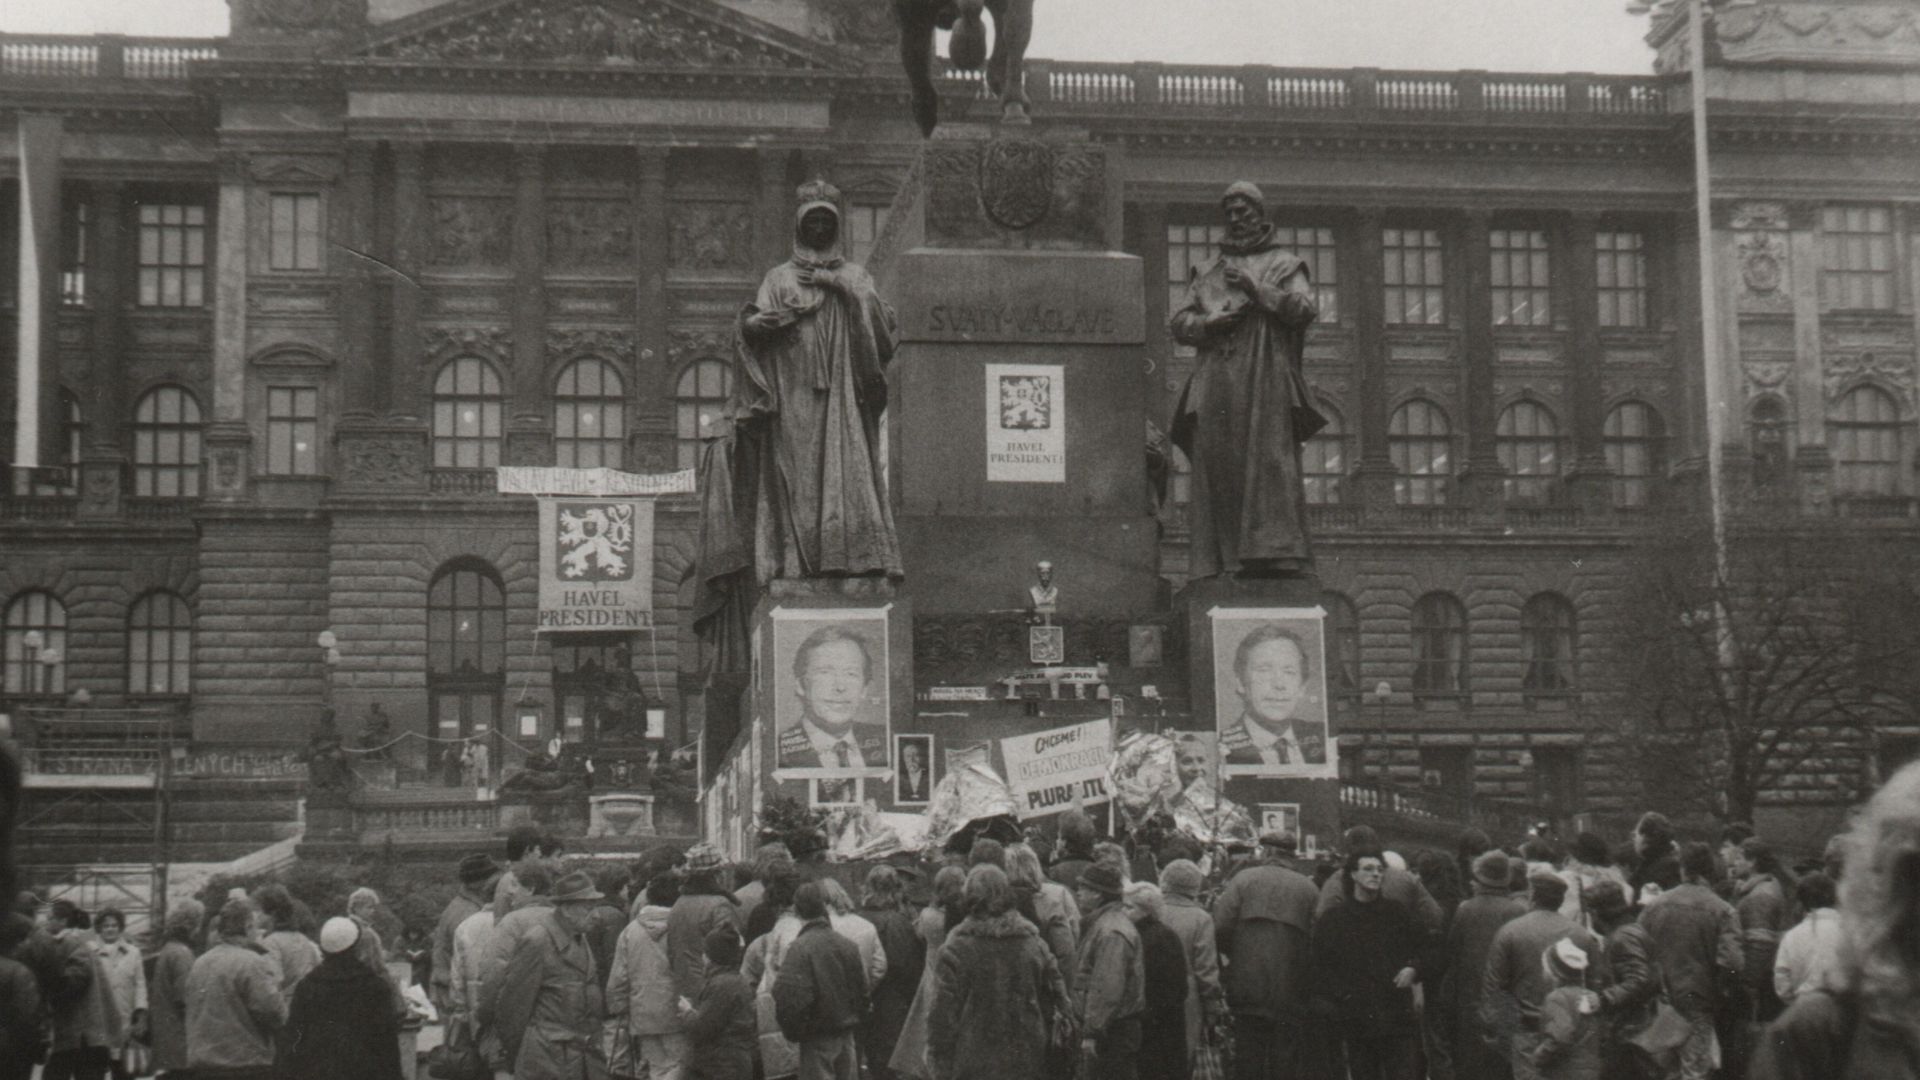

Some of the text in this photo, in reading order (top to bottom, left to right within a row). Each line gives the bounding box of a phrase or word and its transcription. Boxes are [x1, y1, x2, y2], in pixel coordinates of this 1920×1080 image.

[1007, 442, 1046, 452] HAVEL
[563, 590, 625, 607] HAVEL
[539, 608, 651, 627] PRESIDENT
